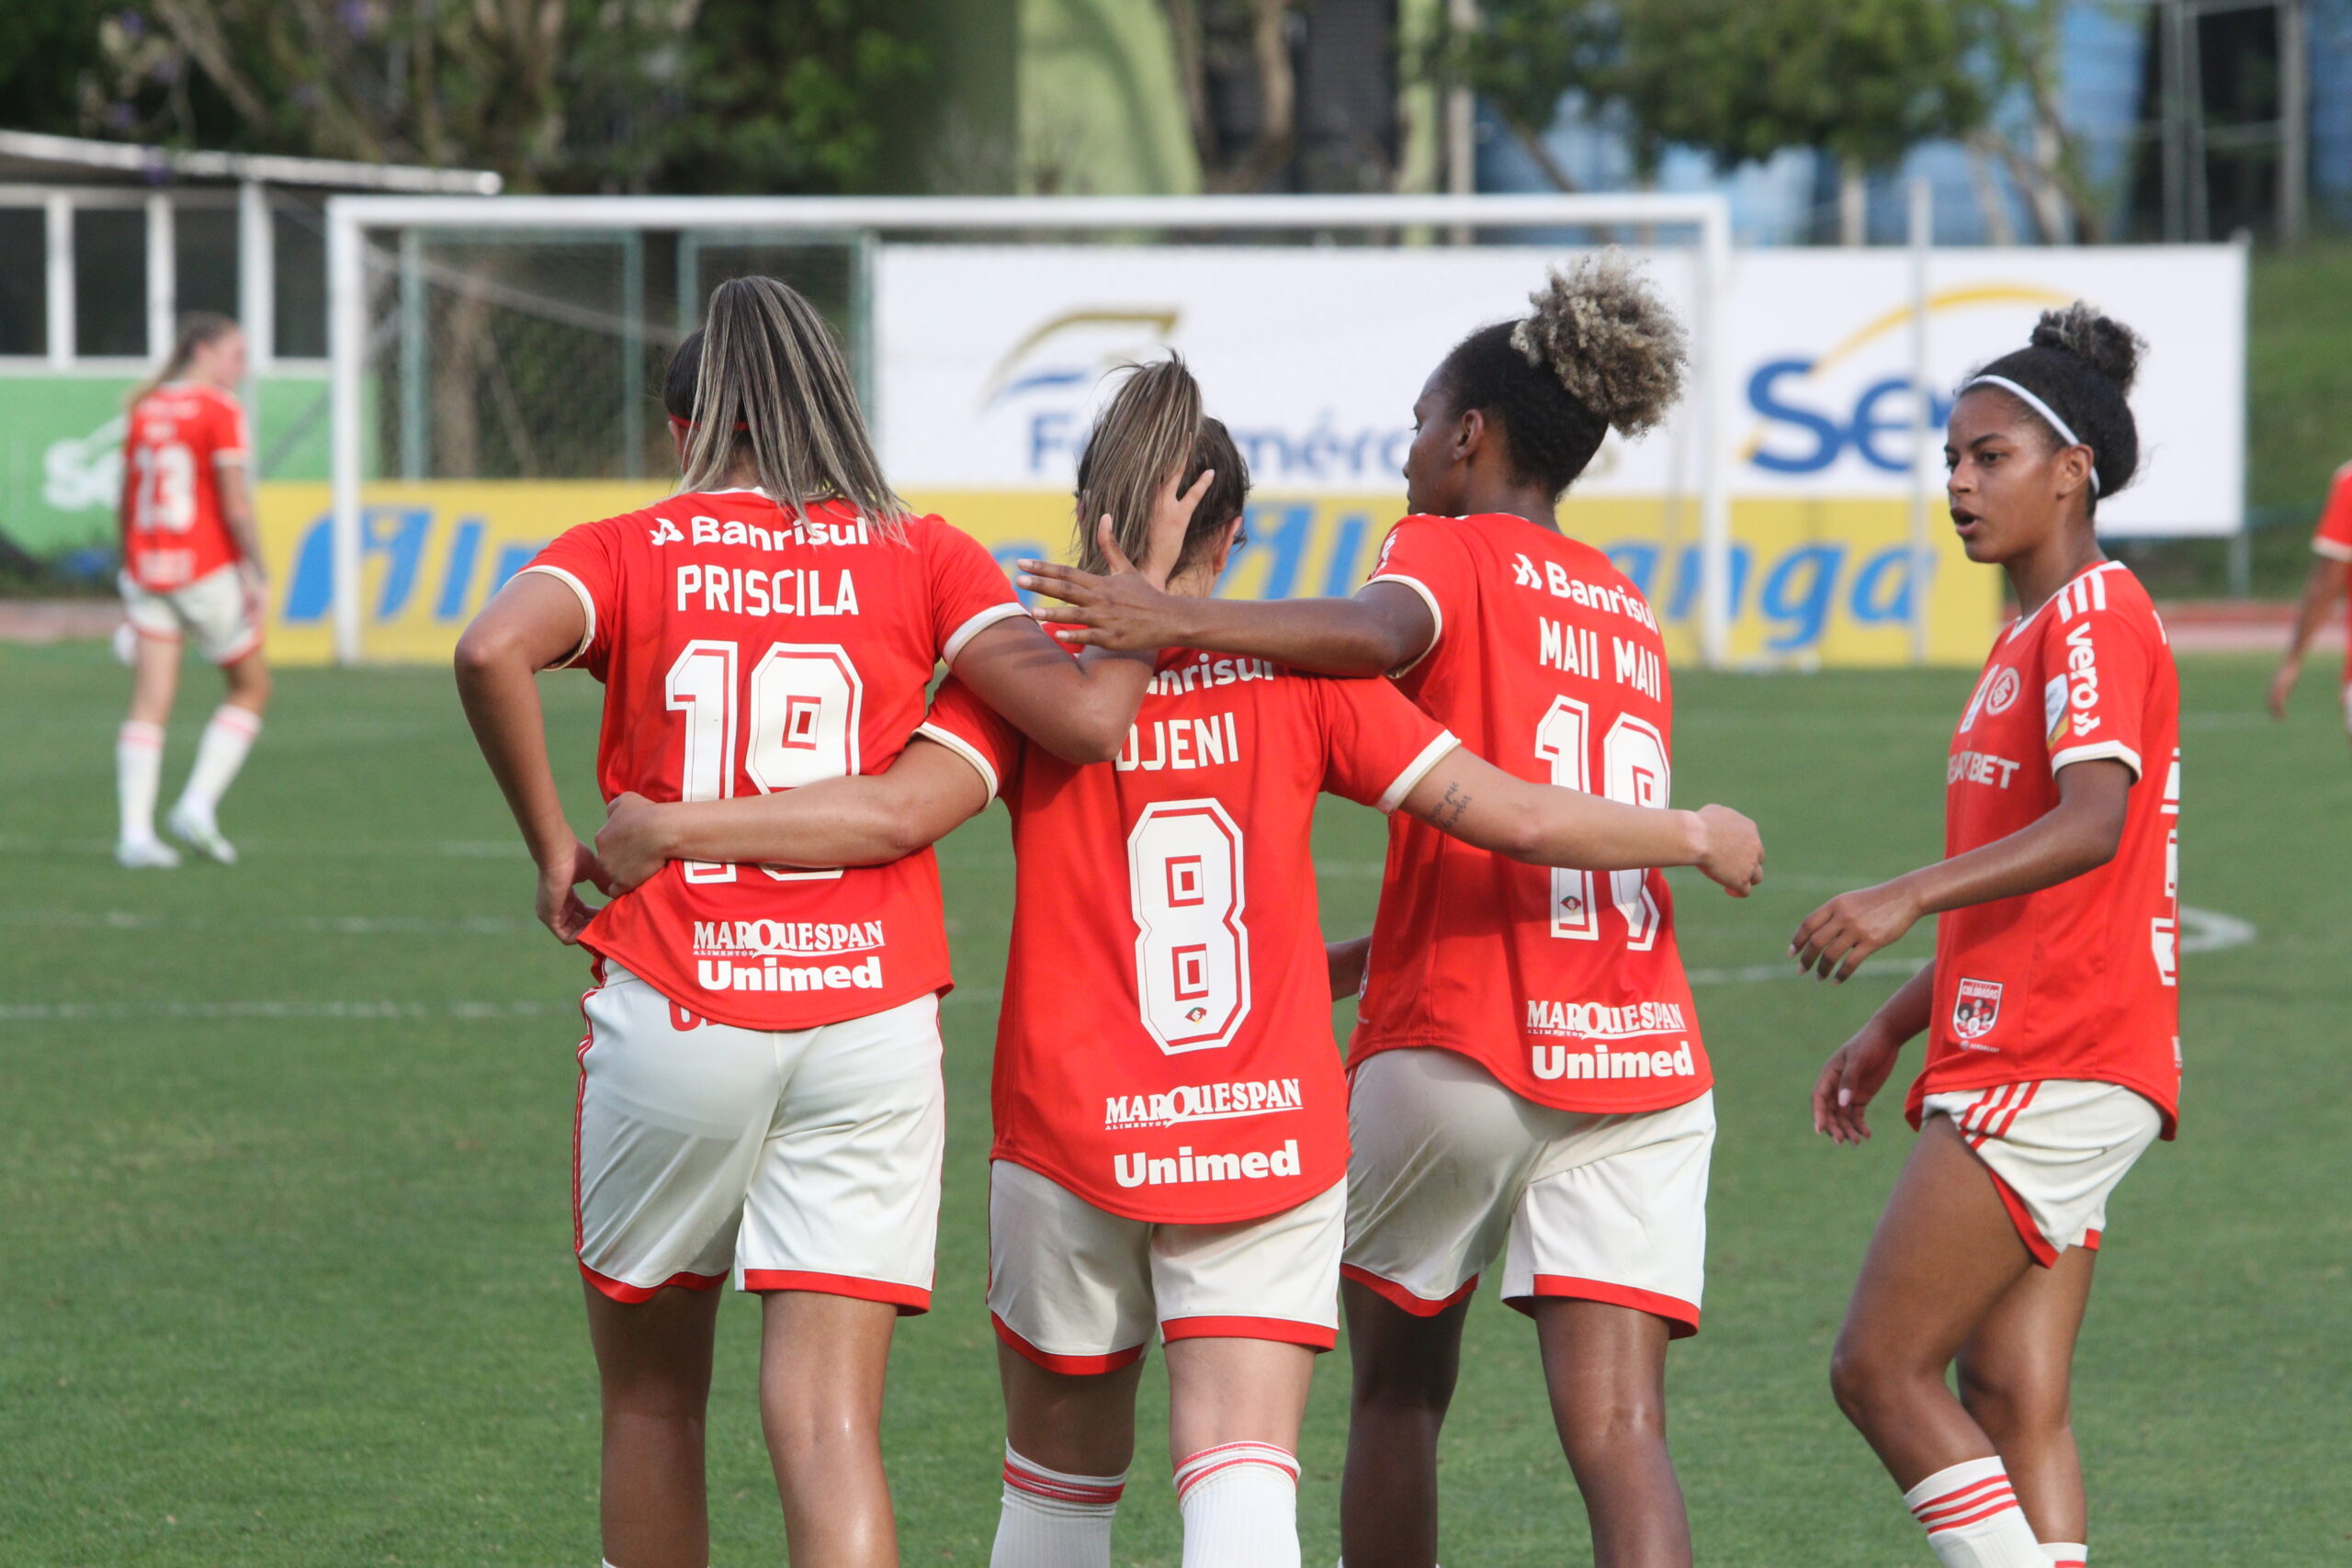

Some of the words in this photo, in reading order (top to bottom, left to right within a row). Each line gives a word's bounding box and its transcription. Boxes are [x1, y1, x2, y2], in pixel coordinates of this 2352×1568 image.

[135, 443, 196, 531] 13
[691, 515, 869, 551] Banrisul
[676, 564, 860, 617] PRISCILA
[694, 919, 886, 957] MARQUESPAN
[1127, 797, 1251, 1055] 8
[698, 956, 883, 992] Unimed
[1526, 999, 1687, 1037] MARQUESPAN
[1532, 1041, 1696, 1080] Unimed
[1105, 1078, 1304, 1125] MARQUESPAN
[1114, 1139, 1301, 1189] Unimed
